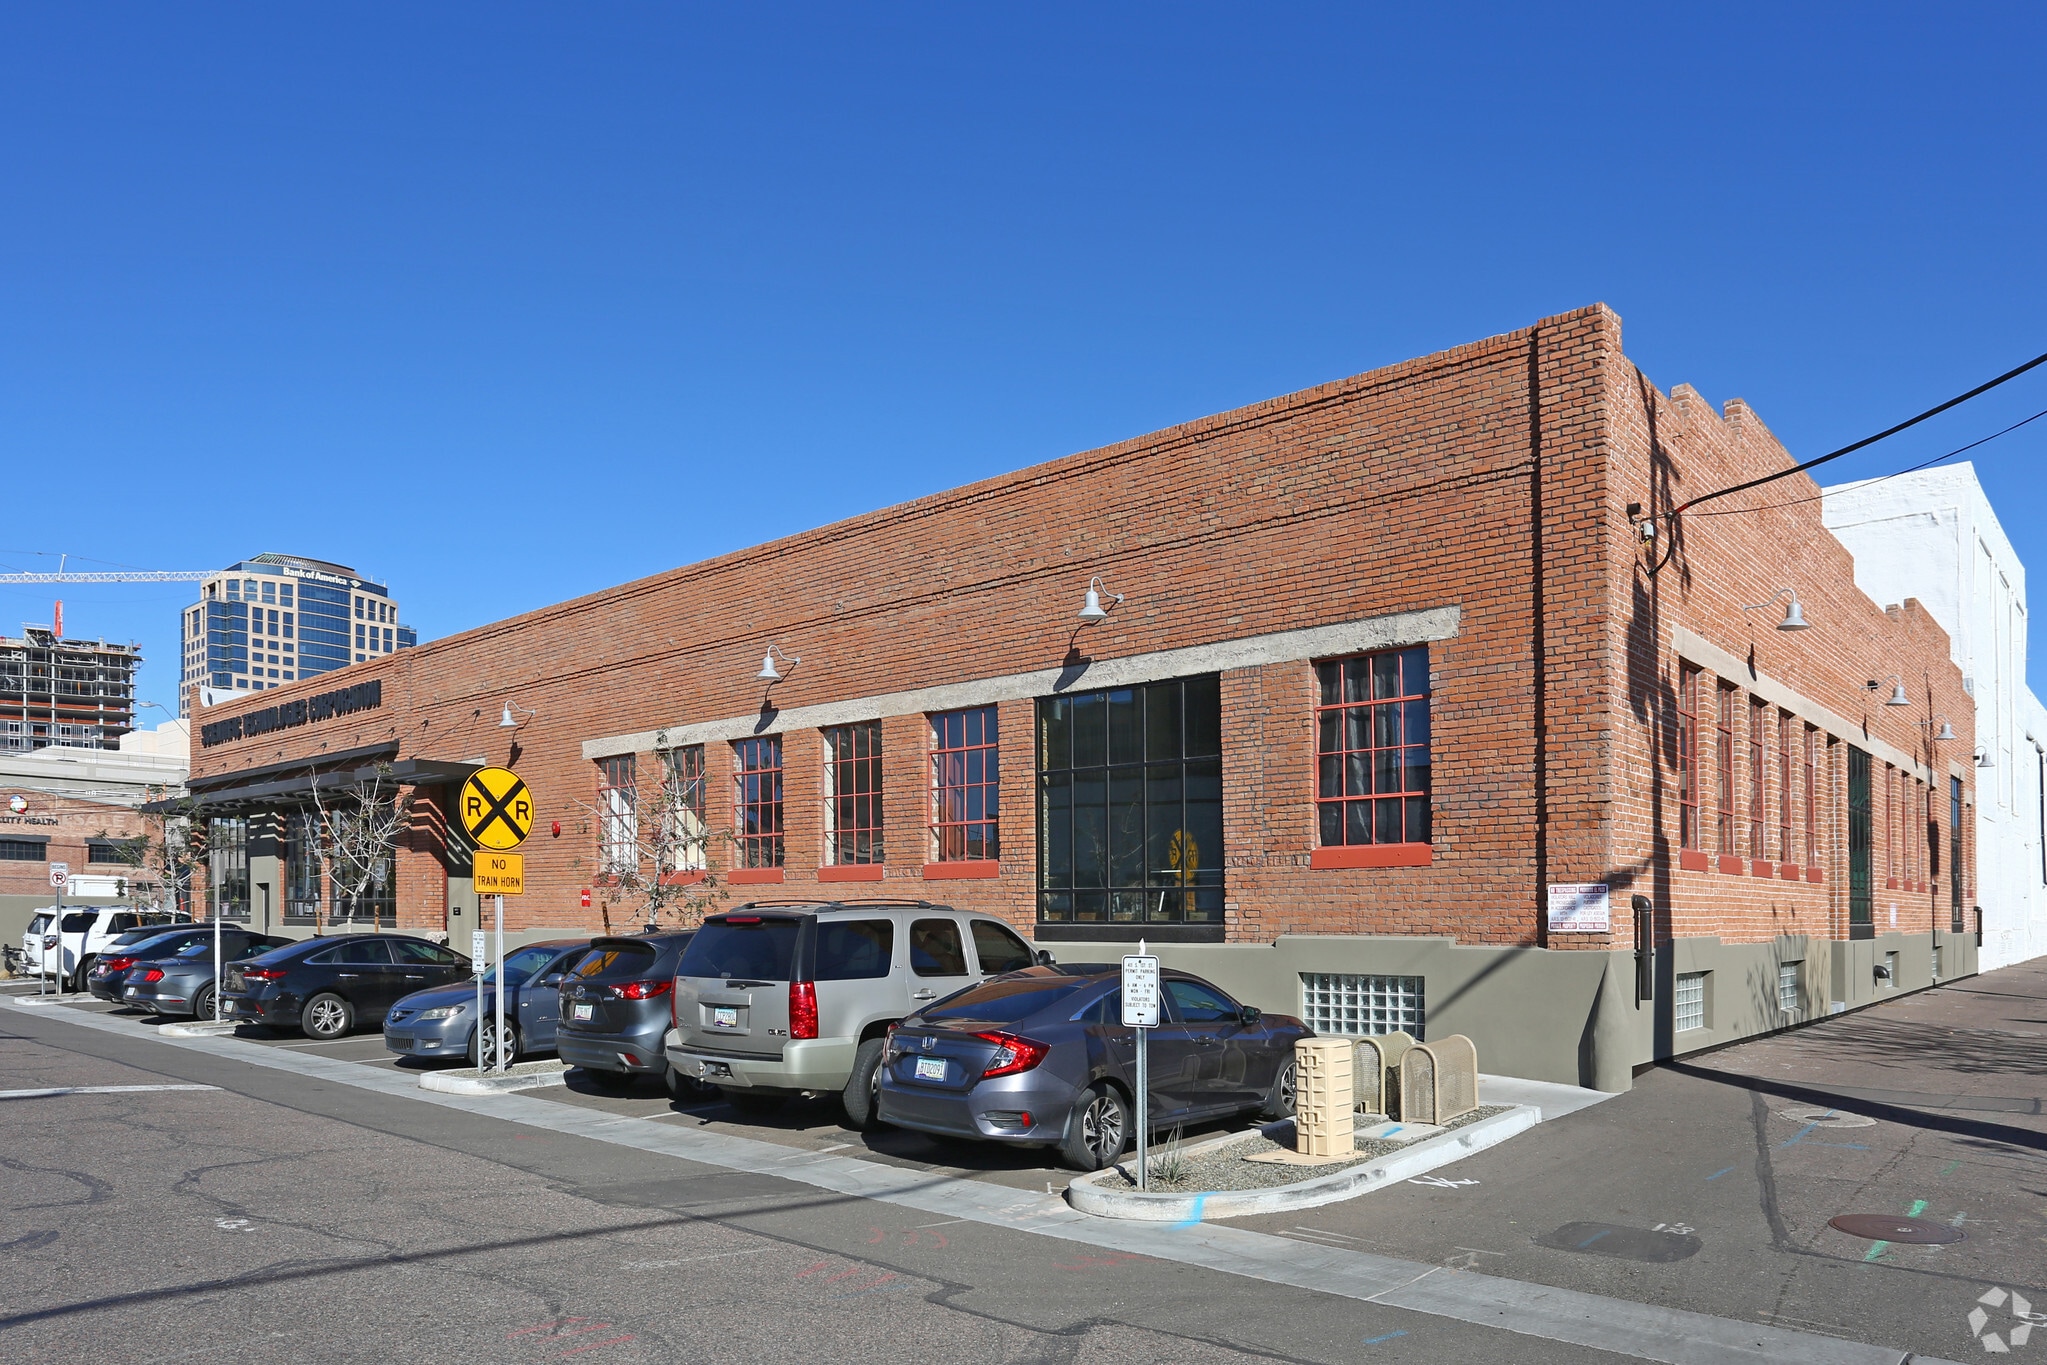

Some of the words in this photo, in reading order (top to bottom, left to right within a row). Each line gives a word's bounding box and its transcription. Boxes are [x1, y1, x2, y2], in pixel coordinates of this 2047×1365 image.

[283, 567, 305, 577] Bank
[306, 571, 315, 579] of
[315, 572, 347, 585] America
[468, 797, 481, 817] R
[516, 801, 529, 821] R
[25, 817, 58, 826] HEALTH
[492, 859, 506, 870] NO
[477, 876, 498, 886] TRAIN
[501, 877, 520, 887] HORN
